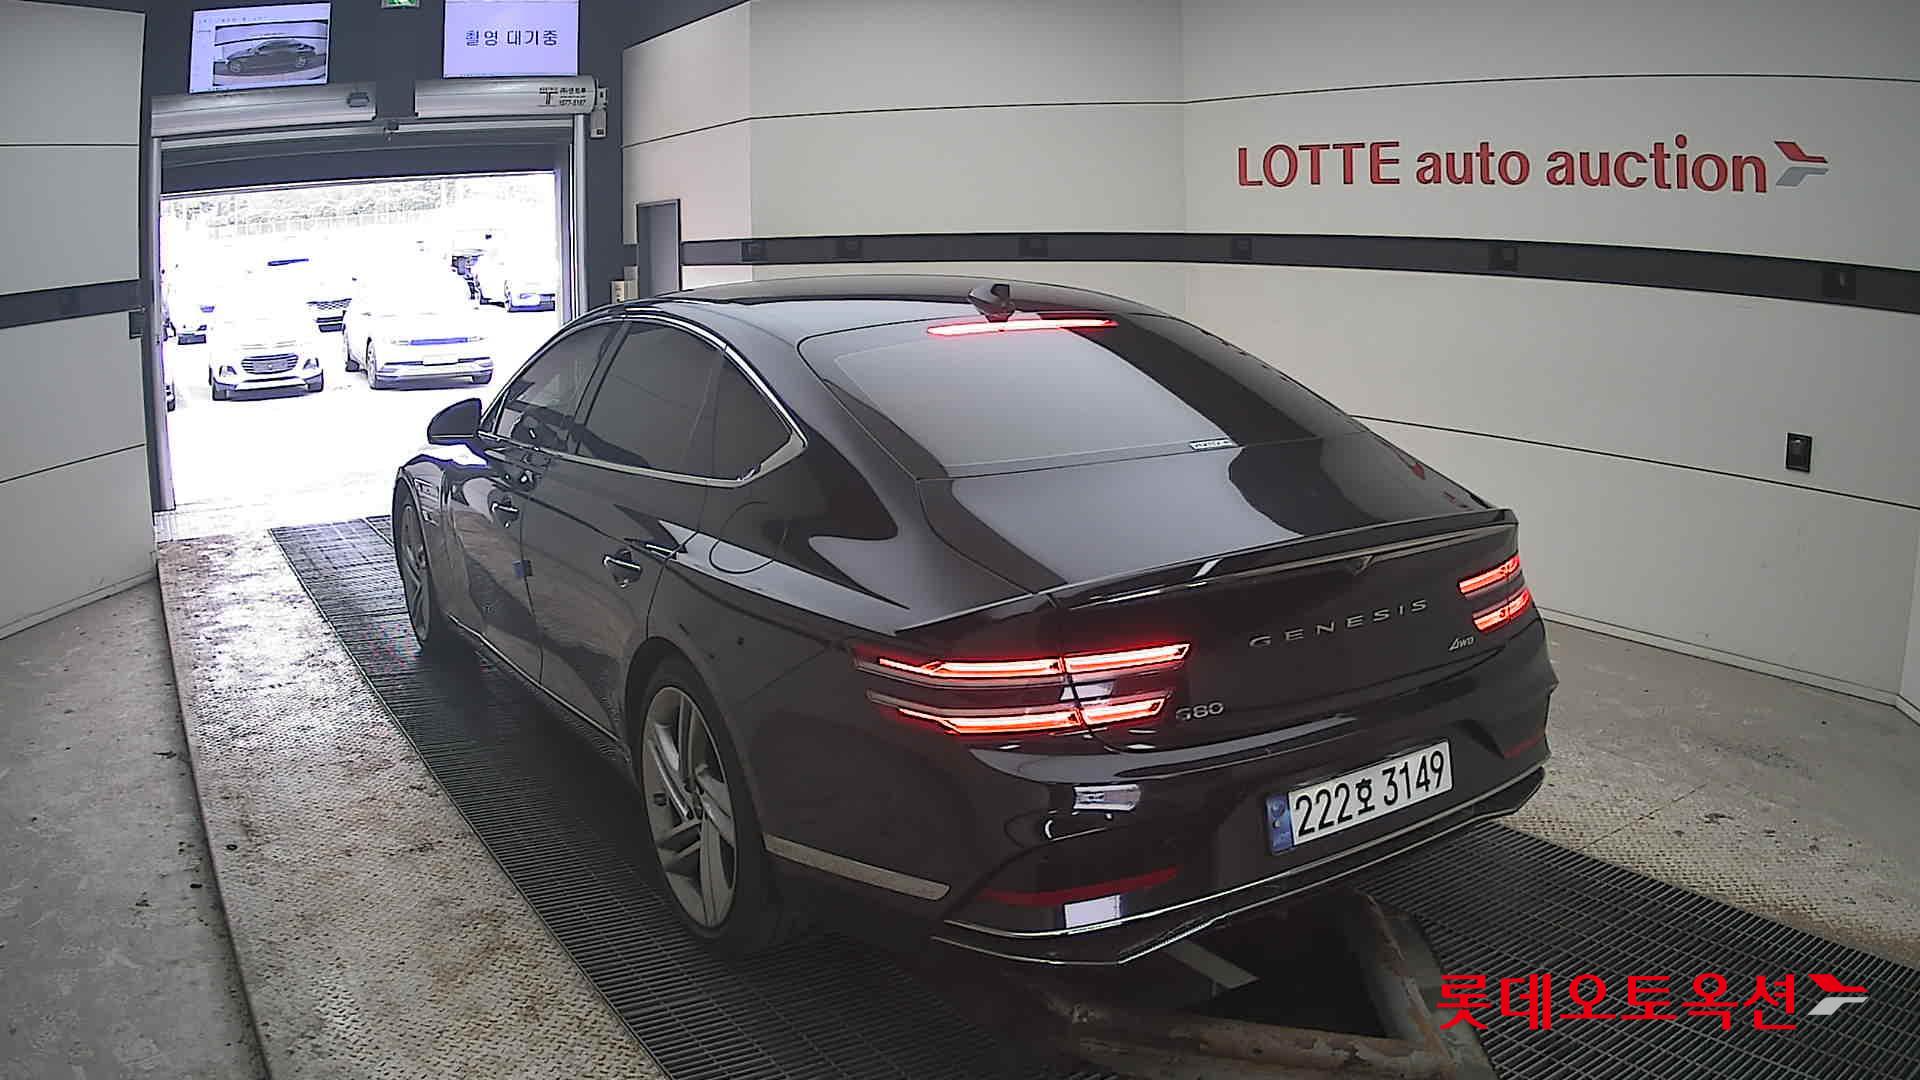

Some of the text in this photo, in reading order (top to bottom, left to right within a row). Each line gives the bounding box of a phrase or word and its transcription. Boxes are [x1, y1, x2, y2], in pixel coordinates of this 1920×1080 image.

[507, 30, 558, 46] 대기중
[1237, 134, 1768, 193] LOTTE auto auction
[1249, 599, 1428, 648] GENESIS
[1175, 702, 1225, 721] G80
[1295, 750, 1445, 838] 222호 3149
